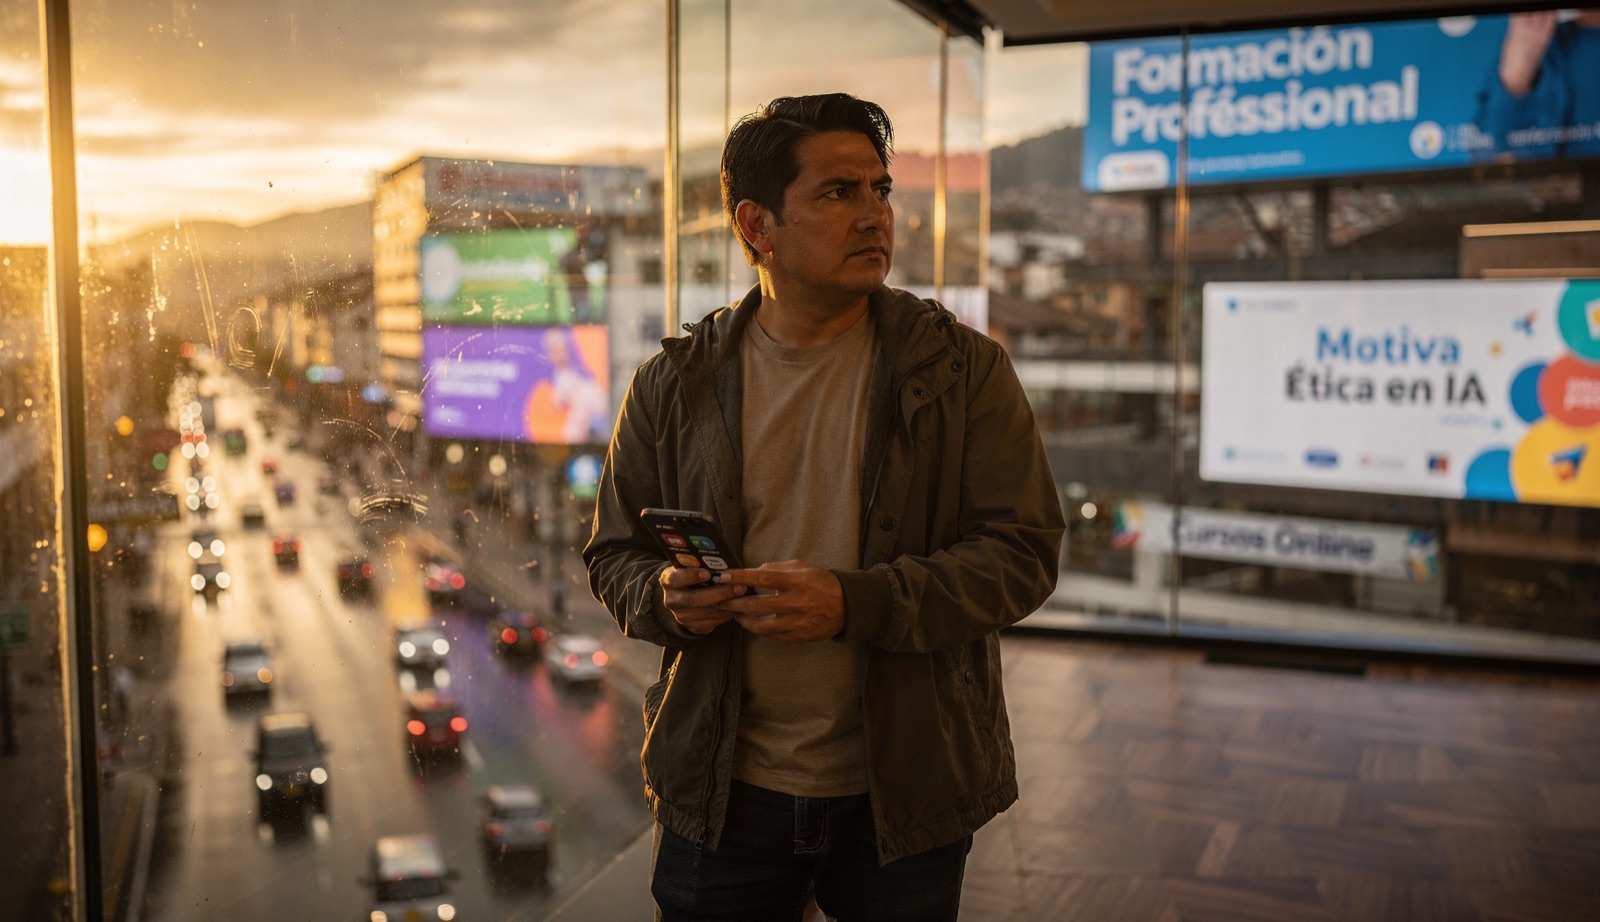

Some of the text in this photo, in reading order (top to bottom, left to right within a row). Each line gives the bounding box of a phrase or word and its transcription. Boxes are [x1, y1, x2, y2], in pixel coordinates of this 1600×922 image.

[1112, 26, 1373, 96] Formación
[1111, 64, 1419, 146] Proféssional
[1317, 325, 1460, 364] Motiva
[1285, 359, 1487, 407] Ética en IA
[1275, 523, 1375, 563] Online
